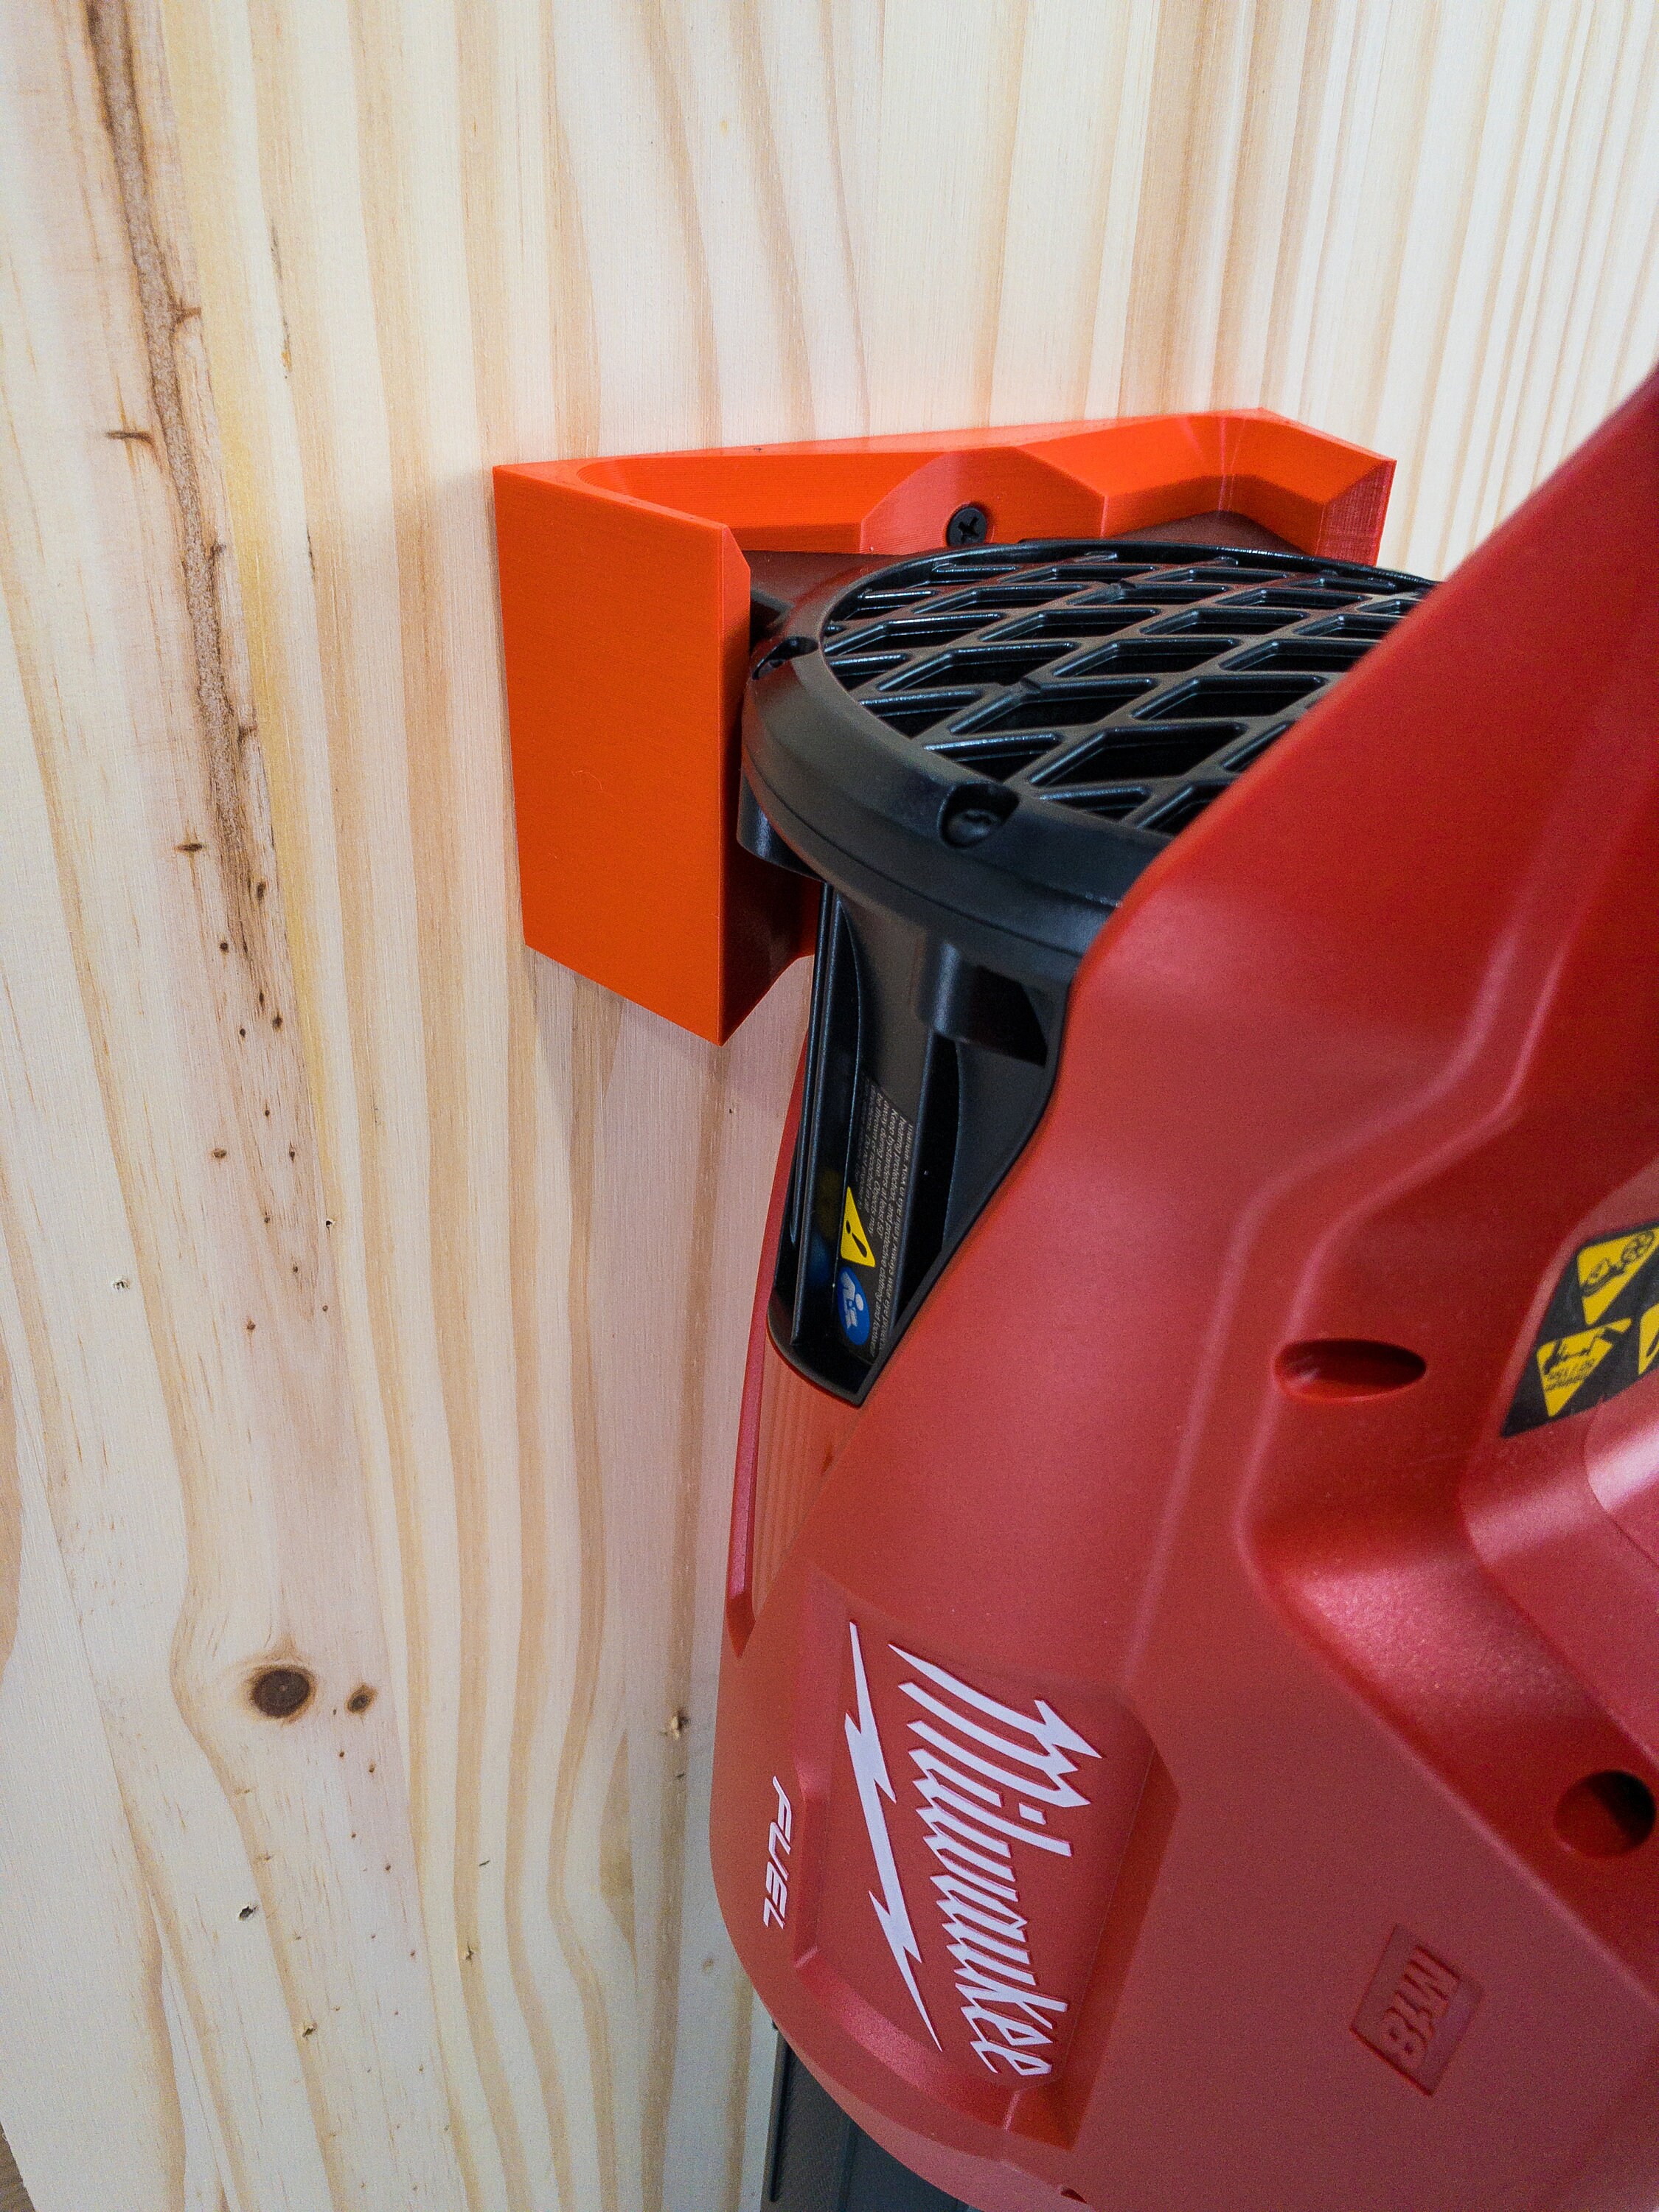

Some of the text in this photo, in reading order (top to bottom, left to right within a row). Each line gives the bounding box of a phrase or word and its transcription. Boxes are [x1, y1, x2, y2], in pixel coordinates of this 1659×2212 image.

[880, 1099, 891, 1130] away
[887, 1106, 898, 1136] Keep
[876, 1125, 887, 1159] during
[893, 1113, 906, 1156] hearing
[880, 1133, 894, 1189] bystanders
[900, 1162, 908, 1186] Risk
[869, 1178, 880, 1217] Objects
[880, 1186, 888, 1200] at
[894, 1194, 903, 1217] eye
[866, 1213, 876, 1238] may
[877, 1197, 887, 1224] least
[886, 1203, 895, 1225] and
[879, 1220, 893, 1269] protective
[887, 1241, 897, 1277] Always
[874, 1265, 887, 1304] clothing
[885, 1276, 894, 1300] wear
[874, 1300, 883, 1322] and
[881, 1297, 891, 1319] eye
[762, 1775, 793, 1930] FUEL
[888, 1644, 1103, 2076] Milwaukee
[1380, 1945, 1461, 2070] M18
